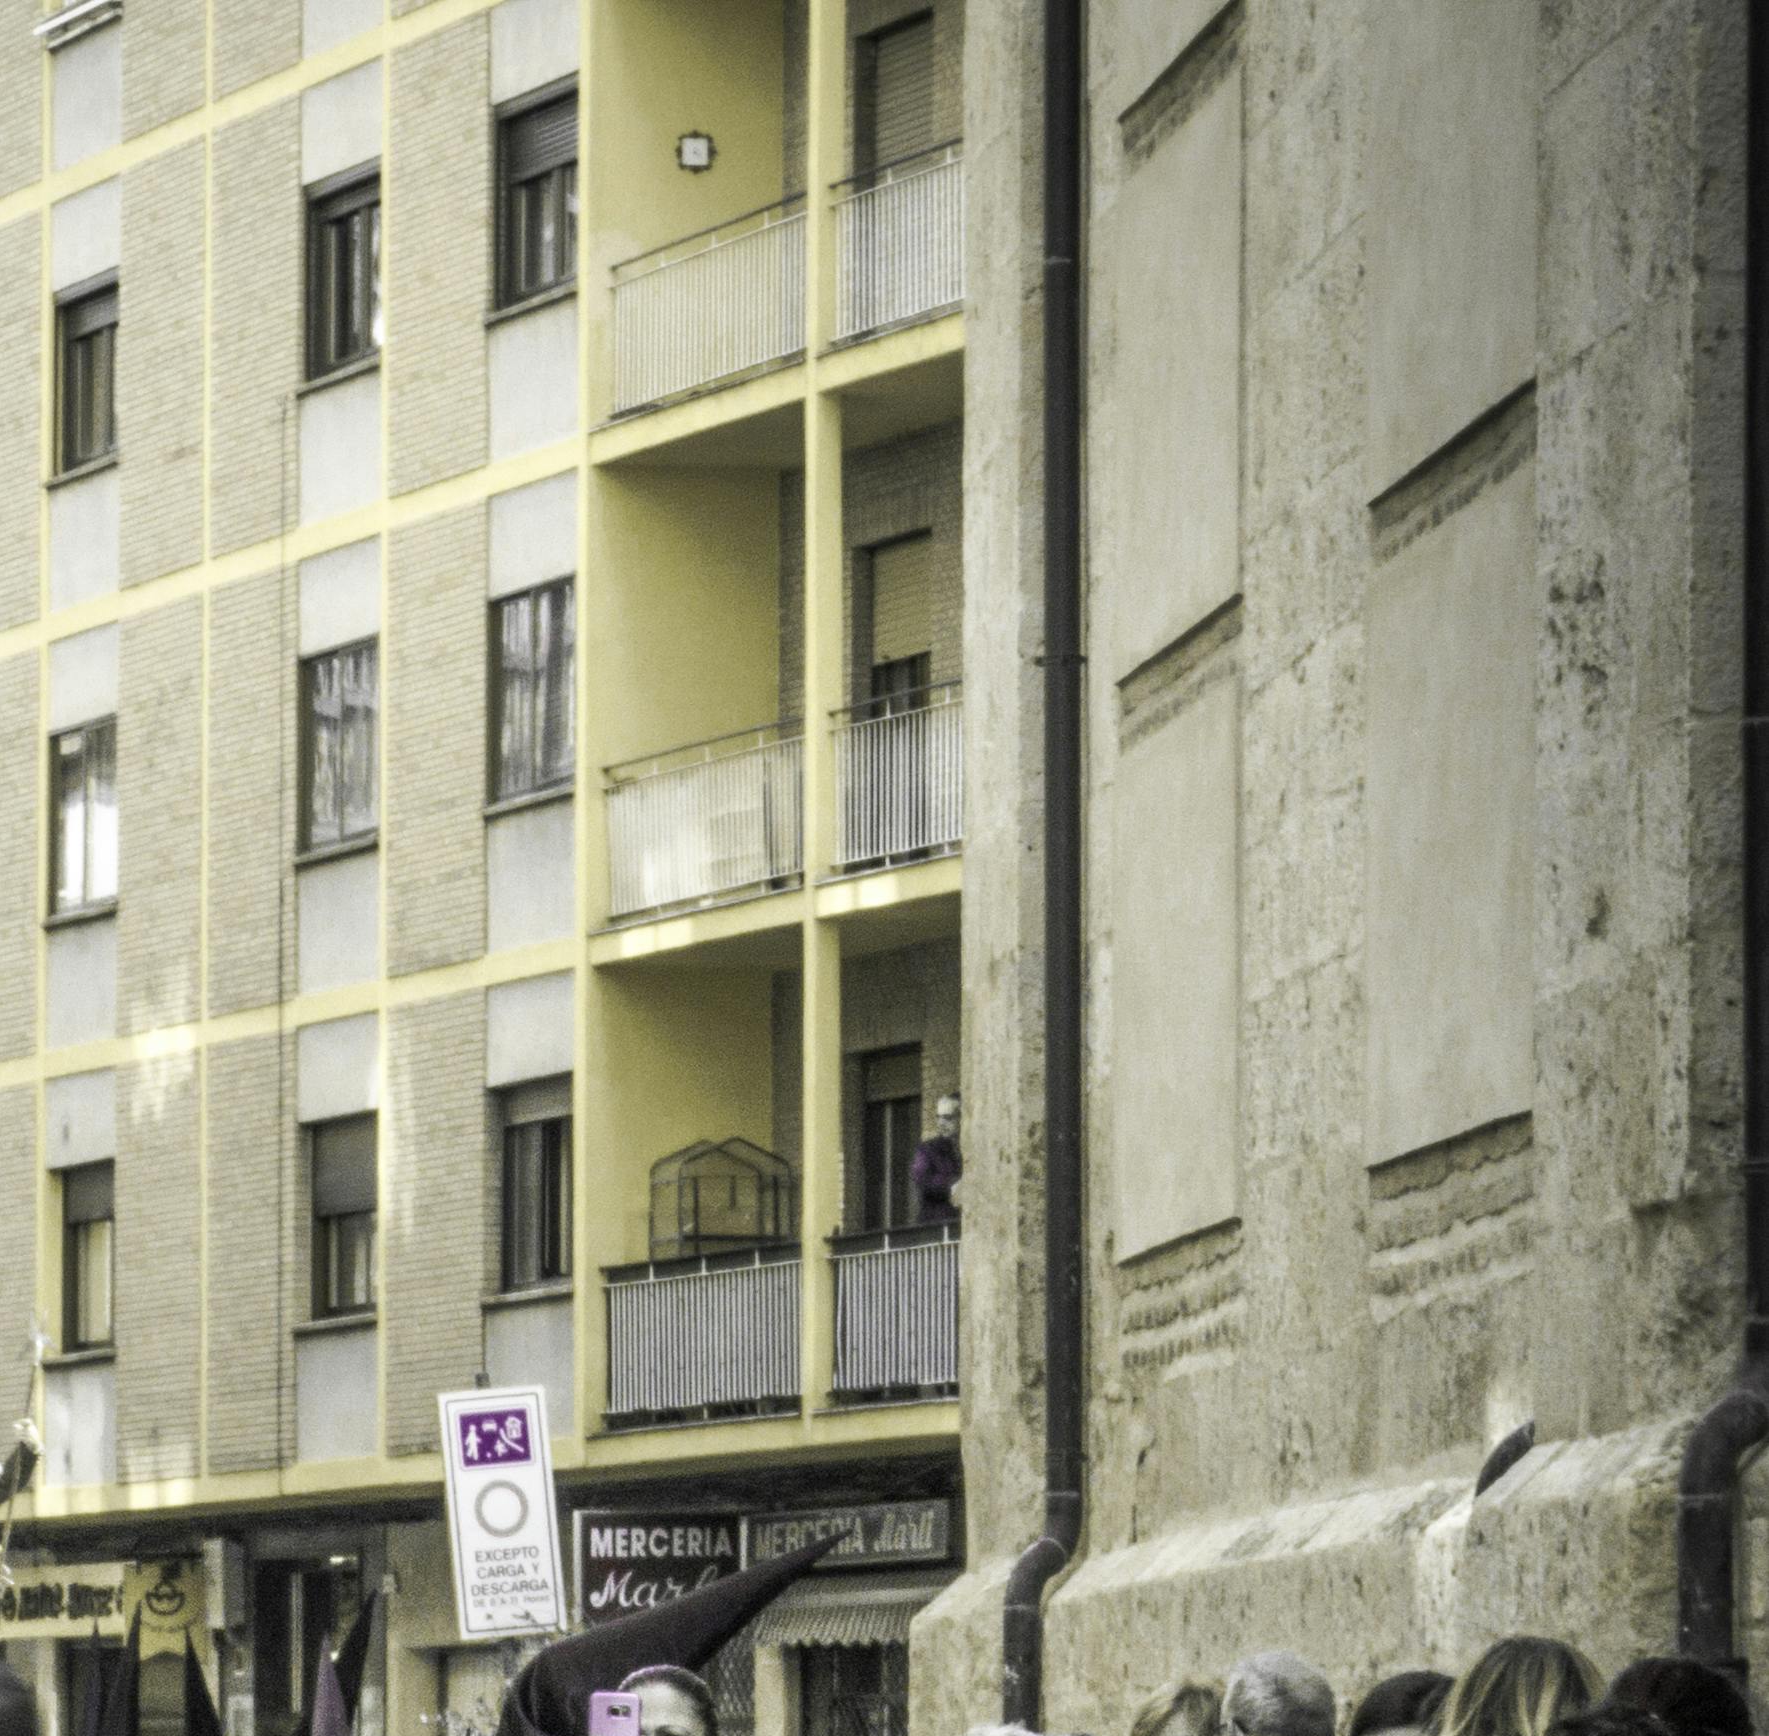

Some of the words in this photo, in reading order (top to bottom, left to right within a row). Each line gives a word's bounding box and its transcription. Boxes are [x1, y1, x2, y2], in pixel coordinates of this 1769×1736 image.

[590, 1527, 734, 1558] MERCERIA
[475, 1546, 539, 1563] EXCEPTO
[476, 1564, 527, 1579] CARGA
[532, 1562, 540, 1575] Y
[472, 1579, 549, 1597] DESCARGA
